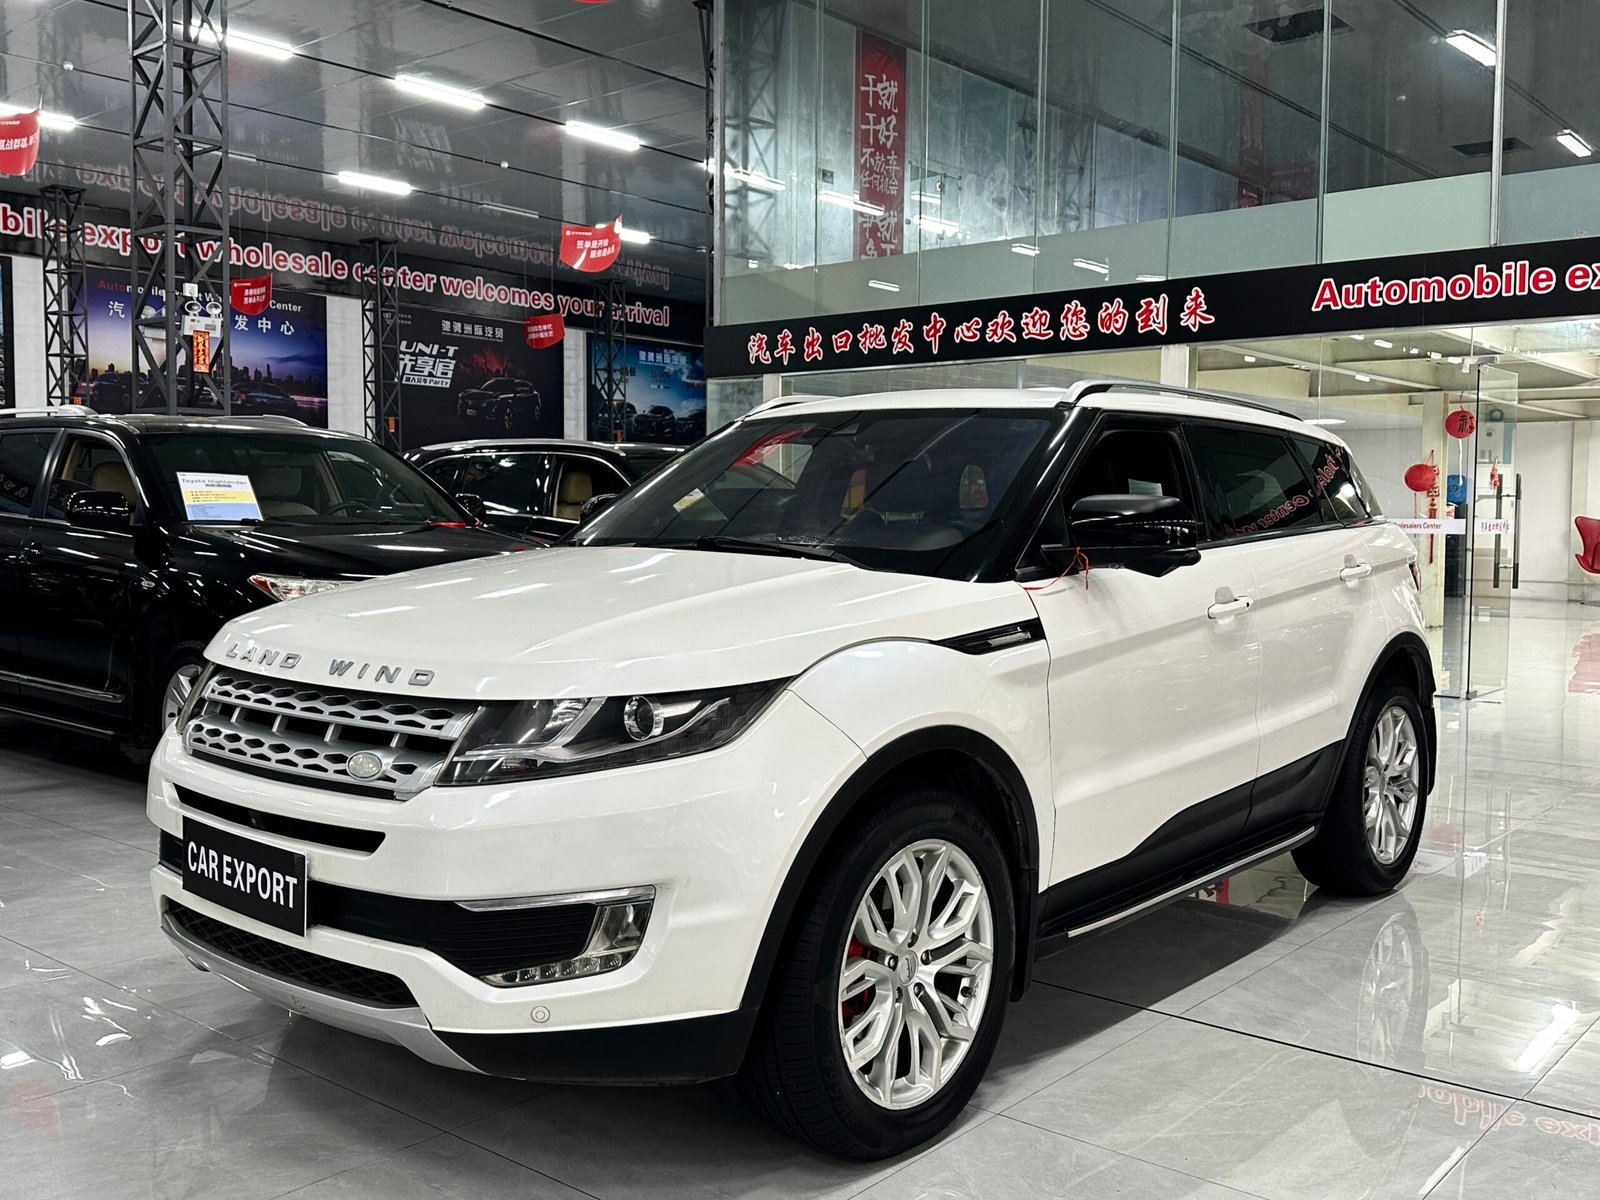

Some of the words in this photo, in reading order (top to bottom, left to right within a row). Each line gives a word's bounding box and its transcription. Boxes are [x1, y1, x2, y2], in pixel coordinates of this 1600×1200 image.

[196, 236, 349, 280] wholesale
[440, 275, 554, 311] welcomes
[1312, 260, 1557, 312] Automobile
[269, 299, 302, 313] Center
[748, 286, 1215, 366] 汽车出口批发中心欢迎您的到来
[399, 340, 459, 357] UNI-T
[226, 642, 301, 668] LAND
[329, 658, 435, 686] WIND
[188, 841, 219, 882] CAR
[223, 854, 298, 909] EXPORT
